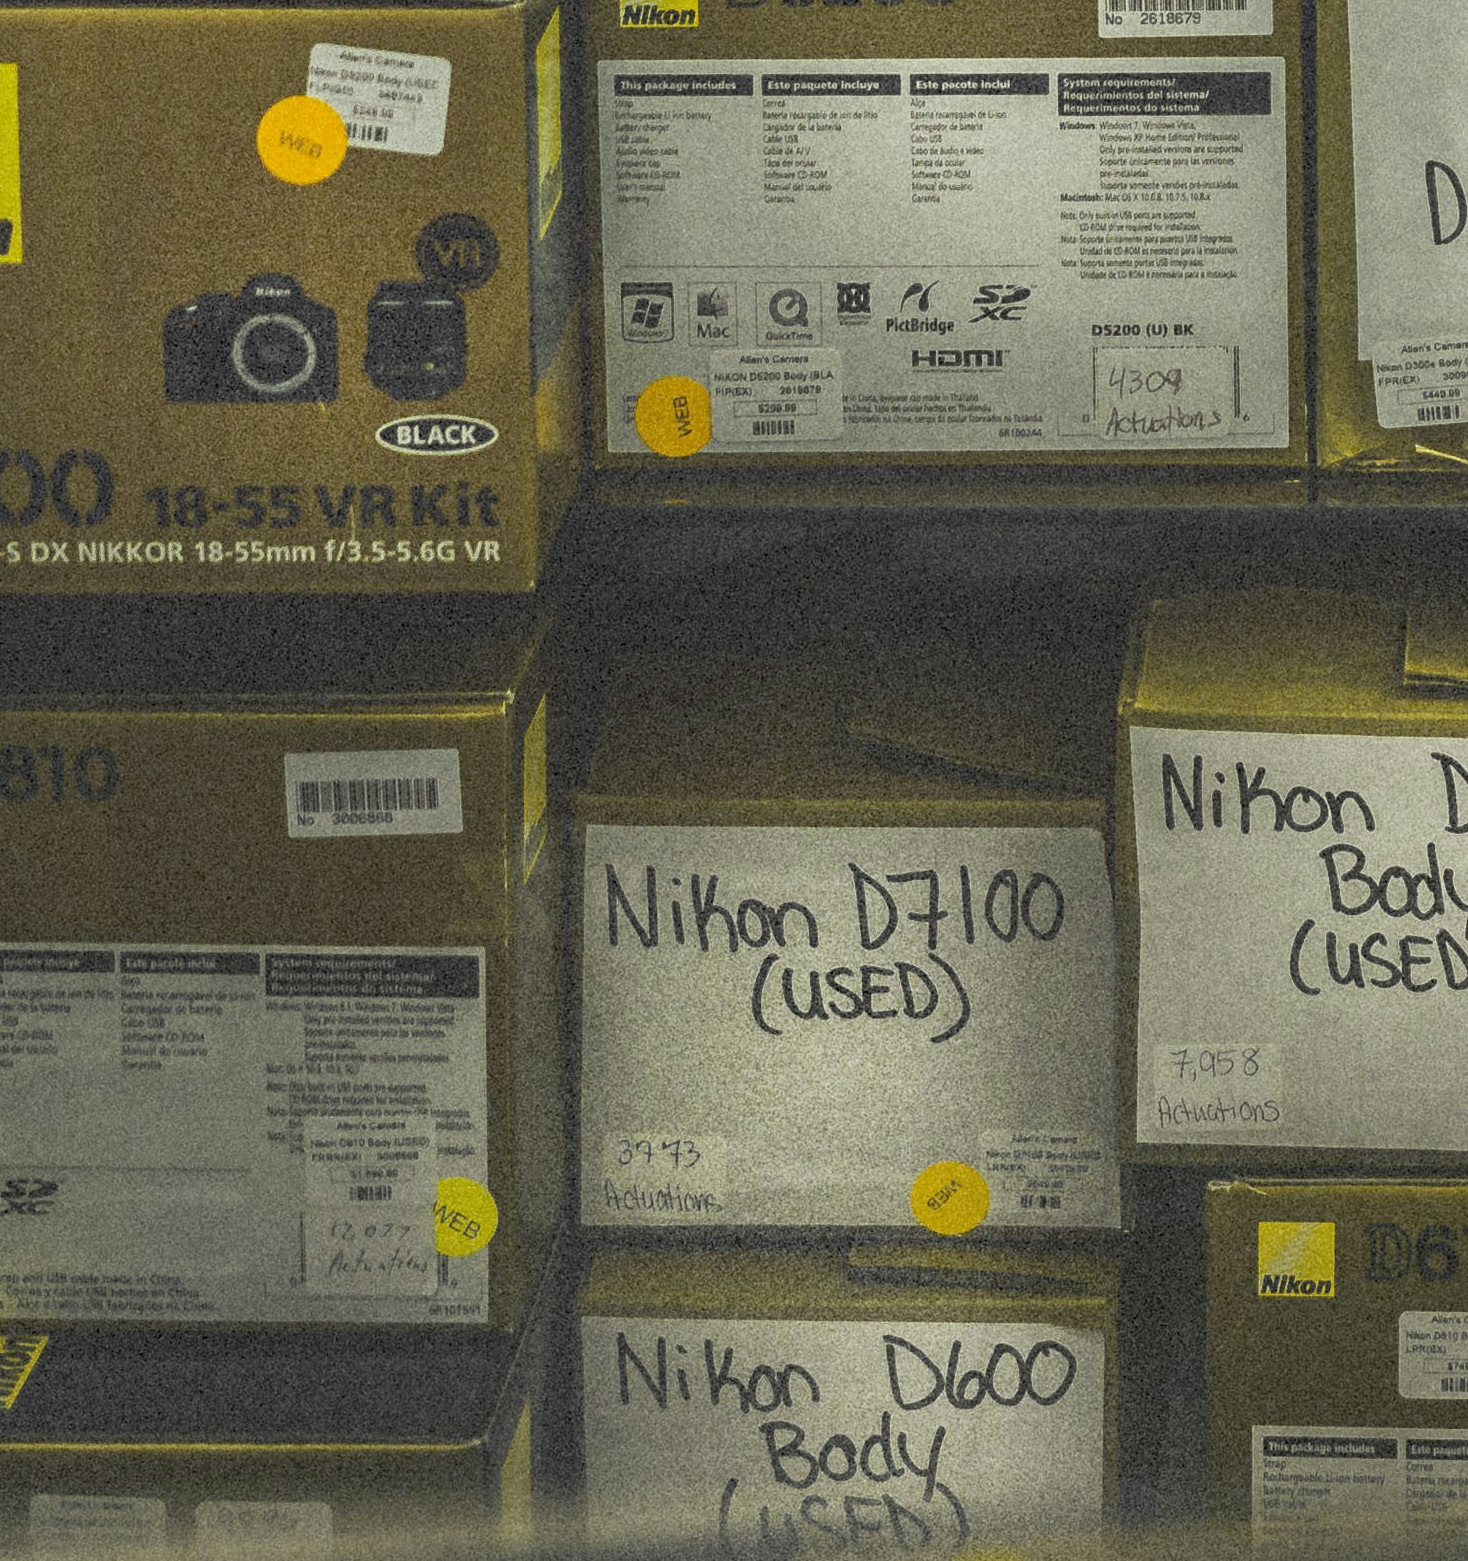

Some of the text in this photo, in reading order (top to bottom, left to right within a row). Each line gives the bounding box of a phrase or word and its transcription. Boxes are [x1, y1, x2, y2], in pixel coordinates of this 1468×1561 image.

[623, 5, 695, 25] Nikon
[433, 240, 483, 267] VR
[886, 318, 955, 335] PictBridge
[394, 424, 477, 445] BLACK
[147, 483, 302, 529] 18-55
[315, 483, 398, 529] VR
[411, 479, 501, 529] Kit
[29, 541, 70, 565] DX
[76, 541, 186, 565] NIKKOR
[193, 541, 317, 565] 18-55mm
[323, 539, 456, 567] f/3.5-5.6G
[464, 541, 501, 565] VR
[1163, 754, 1374, 834] Nikon
[606, 862, 1064, 953] Nikon D7100
[751, 952, 971, 1045] (USED)
[1262, 1272, 1331, 1293] Nikon
[617, 1330, 1076, 1411] Nikon D600
[763, 1420, 945, 1489] Body
